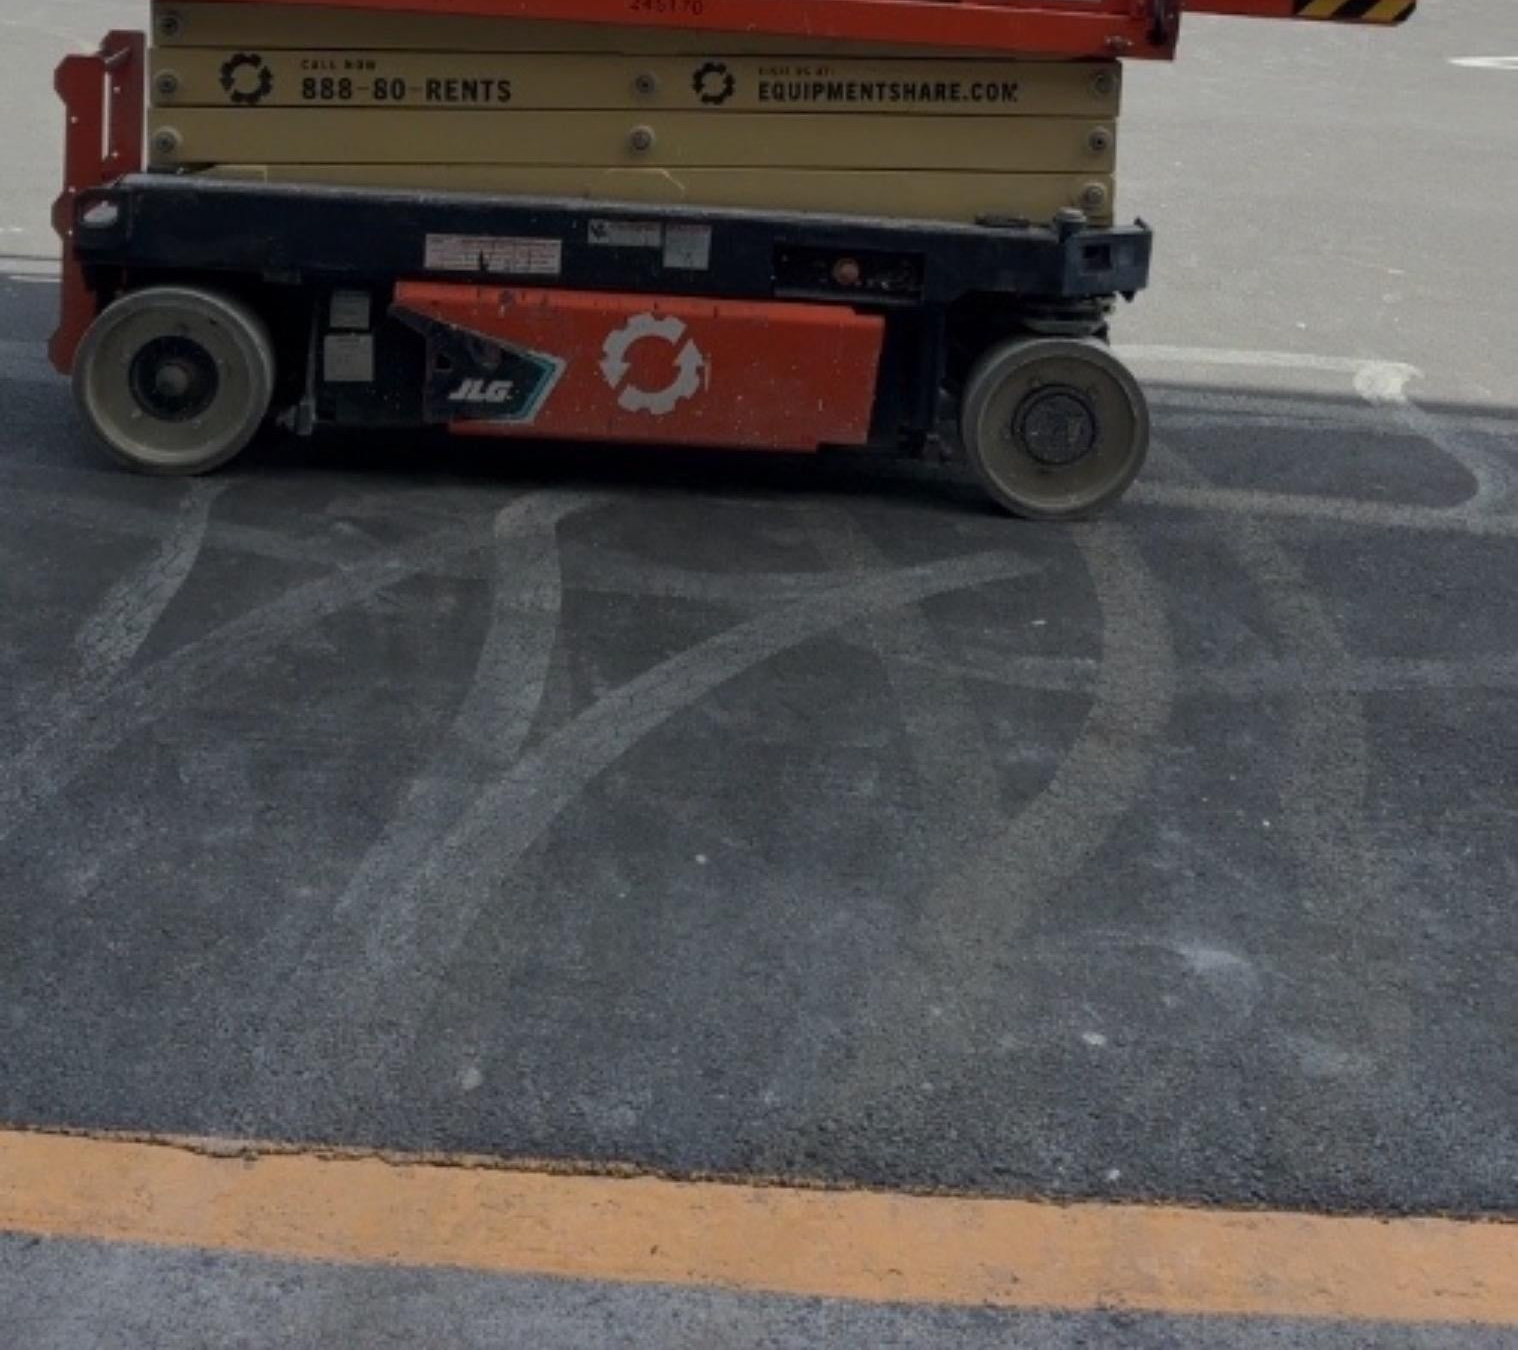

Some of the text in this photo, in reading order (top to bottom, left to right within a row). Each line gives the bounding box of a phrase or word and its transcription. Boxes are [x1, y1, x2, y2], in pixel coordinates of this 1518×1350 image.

[302, 77, 512, 103] 888-80-RENTS
[758, 80, 1018, 103] EQUIPMENTSHARE.COM
[448, 378, 514, 403] JLG
